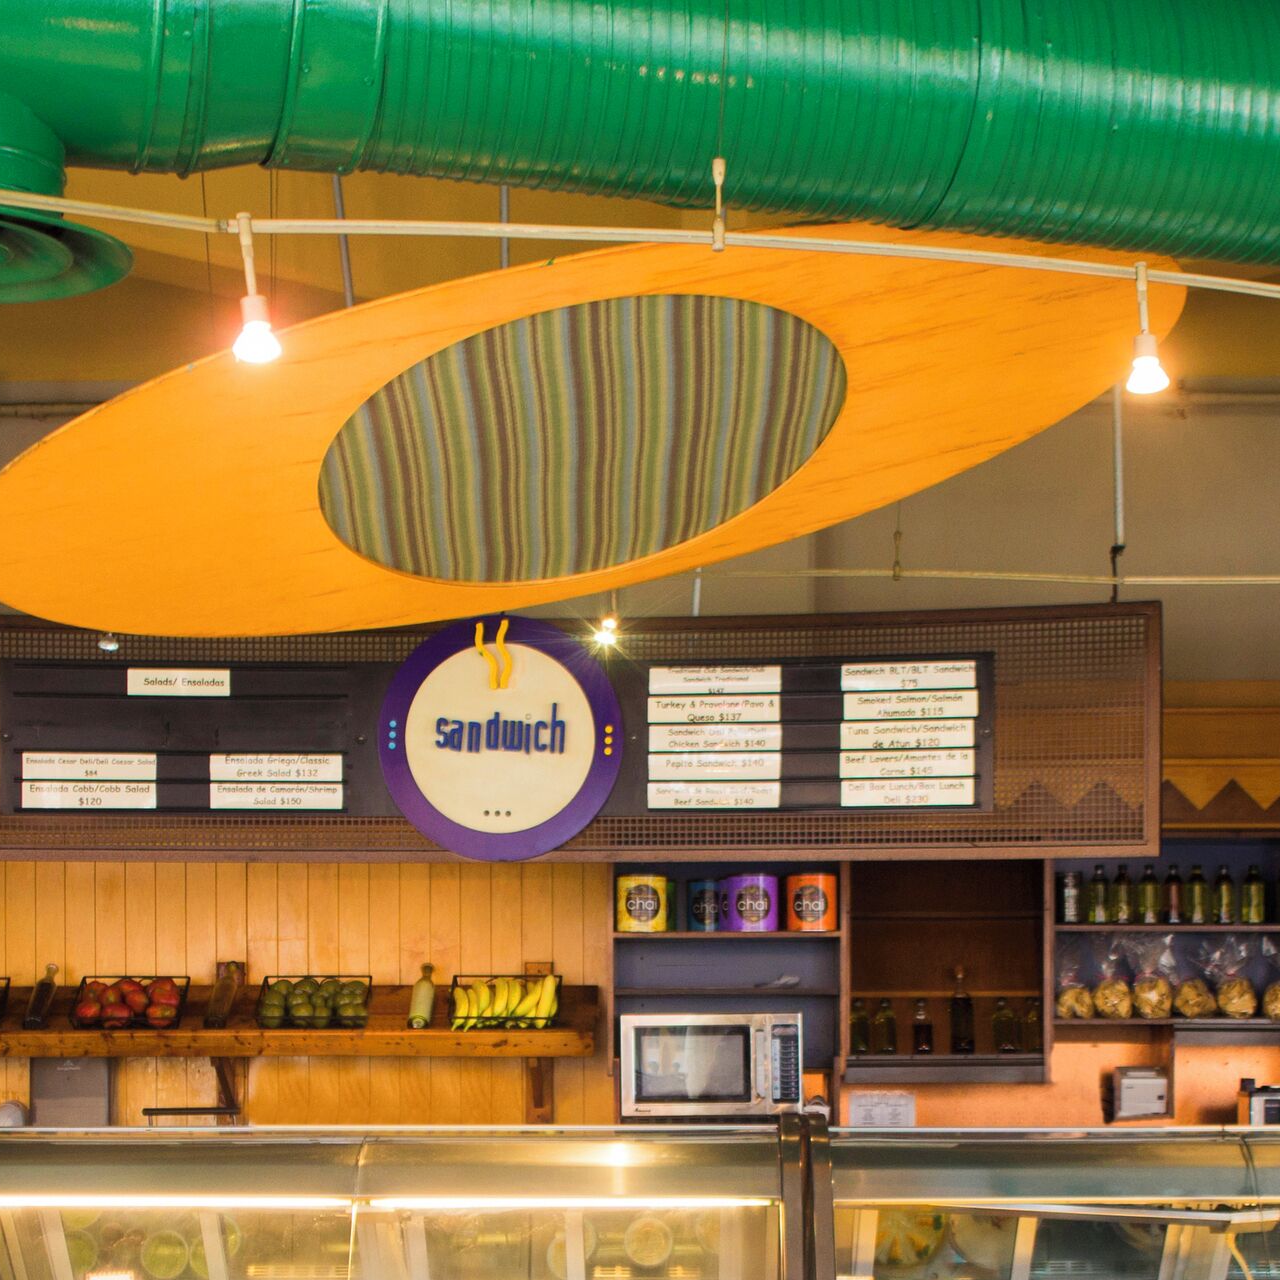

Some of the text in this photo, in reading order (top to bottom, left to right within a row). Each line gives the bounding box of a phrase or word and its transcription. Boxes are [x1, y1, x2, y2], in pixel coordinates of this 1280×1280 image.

[844, 667, 885, 677] Sandwich
[143, 677, 225, 687] Salads/ Ensaladas
[656, 701, 686, 710] Turkey
[768, 699, 774, 708] &
[687, 712, 742, 723] Queso $137
[435, 702, 565, 755] sandwich
[848, 727, 869, 736] Tuna
[668, 740, 700, 748] Chicken
[872, 740, 884, 749] de
[225, 756, 264, 765] Ensalada
[236, 769, 318, 778] Greek Salad $132
[72, 784, 121, 793] Cobb/Cobb
[124, 785, 150, 793] Salad
[217, 785, 253, 793] Ensalada
[256, 785, 266, 793] de
[78, 797, 102, 806] $120
[627, 896, 658, 911] chai
[692, 899, 719, 914] cha
[737, 896, 768, 911] chai
[793, 897, 825, 912] chai
